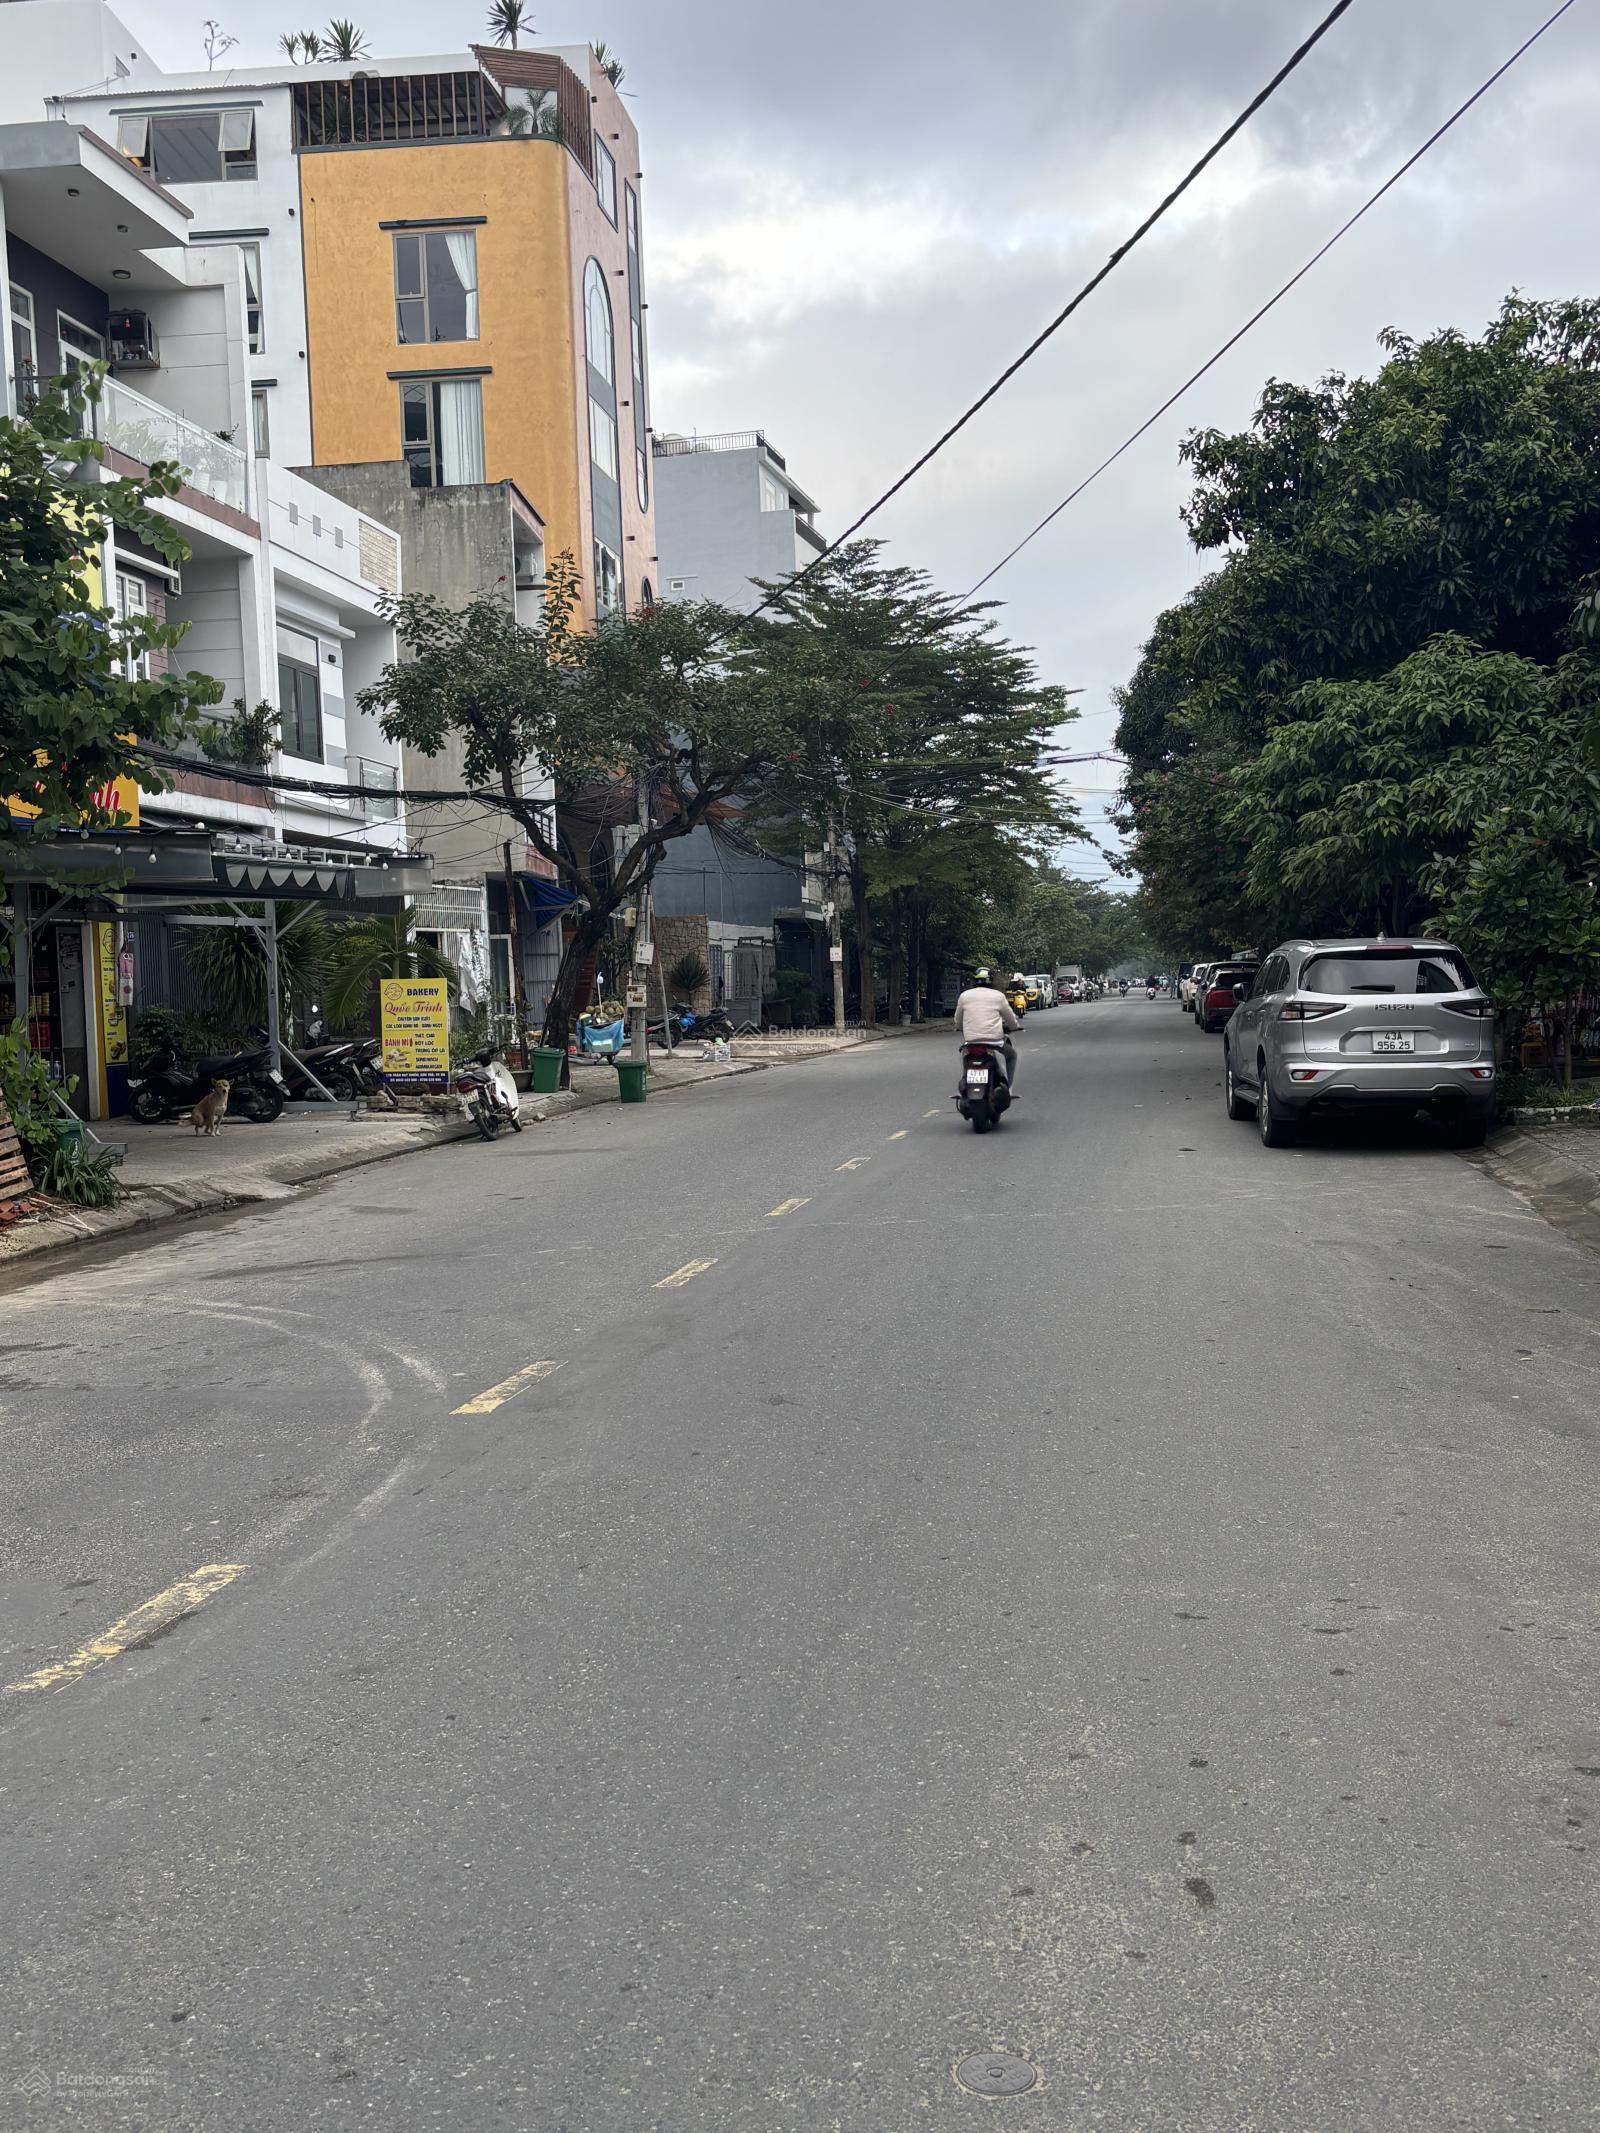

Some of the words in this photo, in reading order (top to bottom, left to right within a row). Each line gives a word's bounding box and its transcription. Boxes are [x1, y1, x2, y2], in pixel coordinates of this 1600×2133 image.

[407, 988, 439, 996] BAKERY
[1384, 1032, 1403, 1041] 43A
[1377, 1041, 1411, 1050] 956.25
